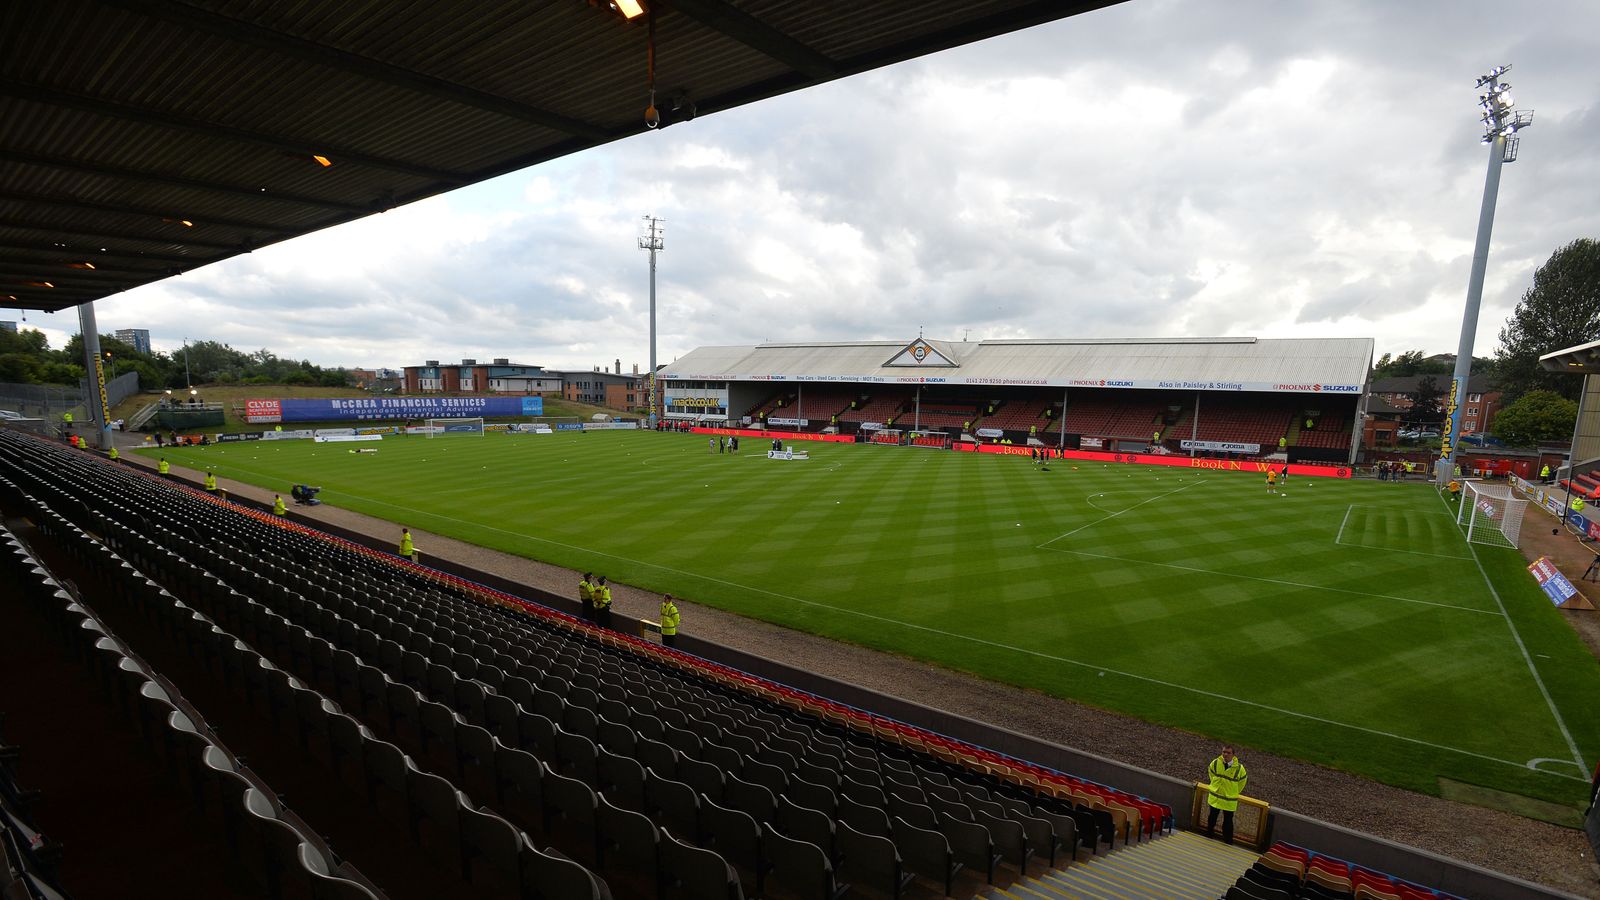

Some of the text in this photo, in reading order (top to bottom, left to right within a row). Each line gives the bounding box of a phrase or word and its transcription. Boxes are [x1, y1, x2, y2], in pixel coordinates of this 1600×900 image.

[1183, 382, 1207, 390] Paisley
[247, 400, 279, 408] CLYDE
[332, 398, 486, 408] McCREA FINANCIAL SERVICES
[672, 397, 720, 407] macb.co.uk
[340, 407, 399, 415] Independent
[1440, 379, 1458, 460] macb.co.uk
[1004, 445, 1030, 456] Book
[1191, 458, 1225, 470] Book
